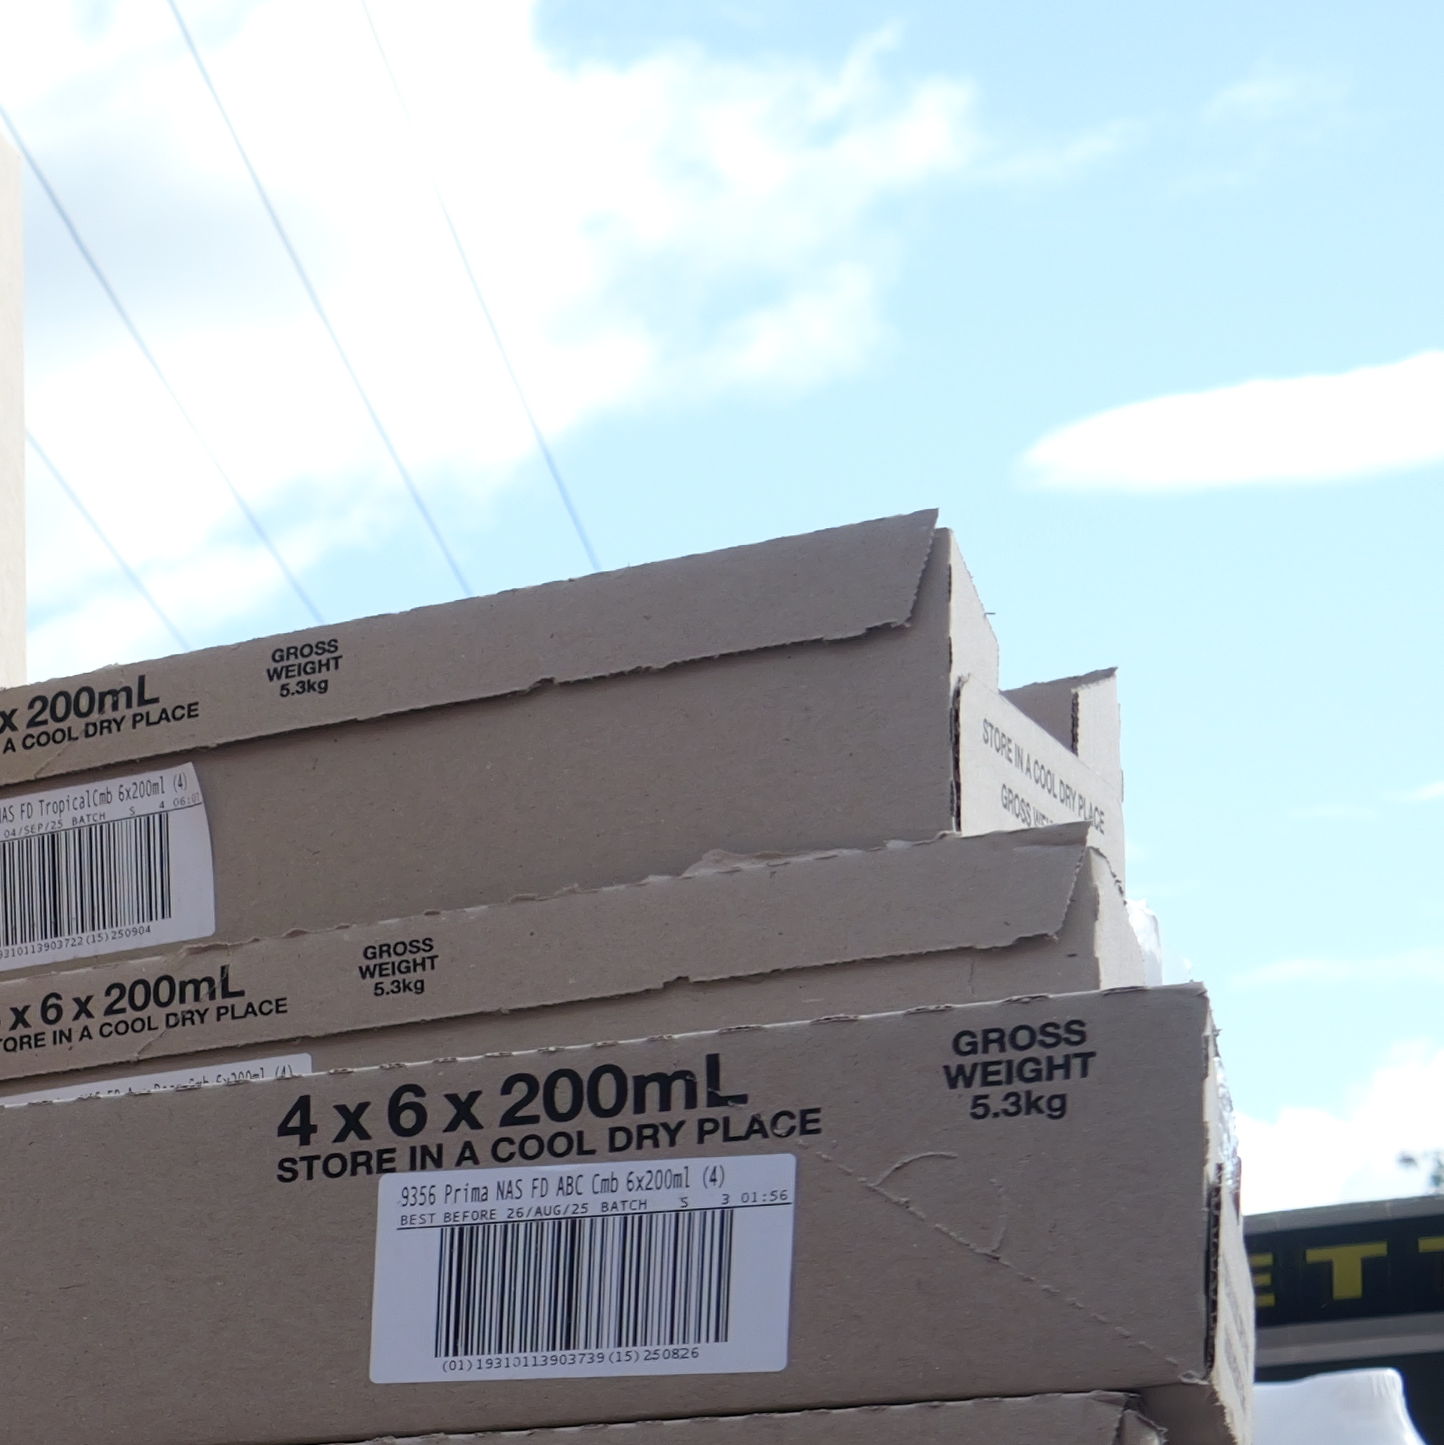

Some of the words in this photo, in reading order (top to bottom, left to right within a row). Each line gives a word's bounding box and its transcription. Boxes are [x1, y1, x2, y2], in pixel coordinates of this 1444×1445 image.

[266, 655, 343, 682] WEIGHT
[271, 639, 339, 664] GROSS
[27, 674, 160, 727] 200mL
[279, 676, 329, 698] 5.3kg
[2, 737, 16, 754] A
[22, 725, 78, 752] COOL
[84, 715, 127, 741] DRY
[131, 701, 200, 731] PLACE
[951, 1020, 1088, 1058] GROSS
[943, 1051, 1097, 1091] WEIGHT
[276, 1094, 318, 1146] 4
[333, 1101, 373, 1142] x
[387, 1083, 429, 1138] 6
[444, 1091, 484, 1131] x
[498, 1051, 749, 1128] 200mL
[969, 1090, 1068, 1122] 5.3kg
[276, 1149, 397, 1184] STORE
[408, 1145, 443, 1173] IN
[453, 1140, 480, 1167] A
[490, 1132, 598, 1166] COOL
[607, 1122, 688, 1154] DRY
[696, 1107, 823, 1146] PLACE
[401, 1184, 437, 1207] 9356
[444, 1182, 489, 1205] Prima
[496, 1179, 524, 1200] NAS
[531, 1177, 549, 1198] FD
[556, 1174, 584, 1196] ABC
[591, 1172, 619, 1193] Cmb
[626, 1166, 691, 1192] 6x200ml
[702, 1164, 726, 1189] (4)
[400, 1212, 435, 1227] BEST
[443, 1208, 497, 1224] BEFORE
[506, 1202, 589, 1220] 26/AUG/25
[601, 1199, 648, 1213] BATCH
[741, 1190, 789, 1205] 01:56
